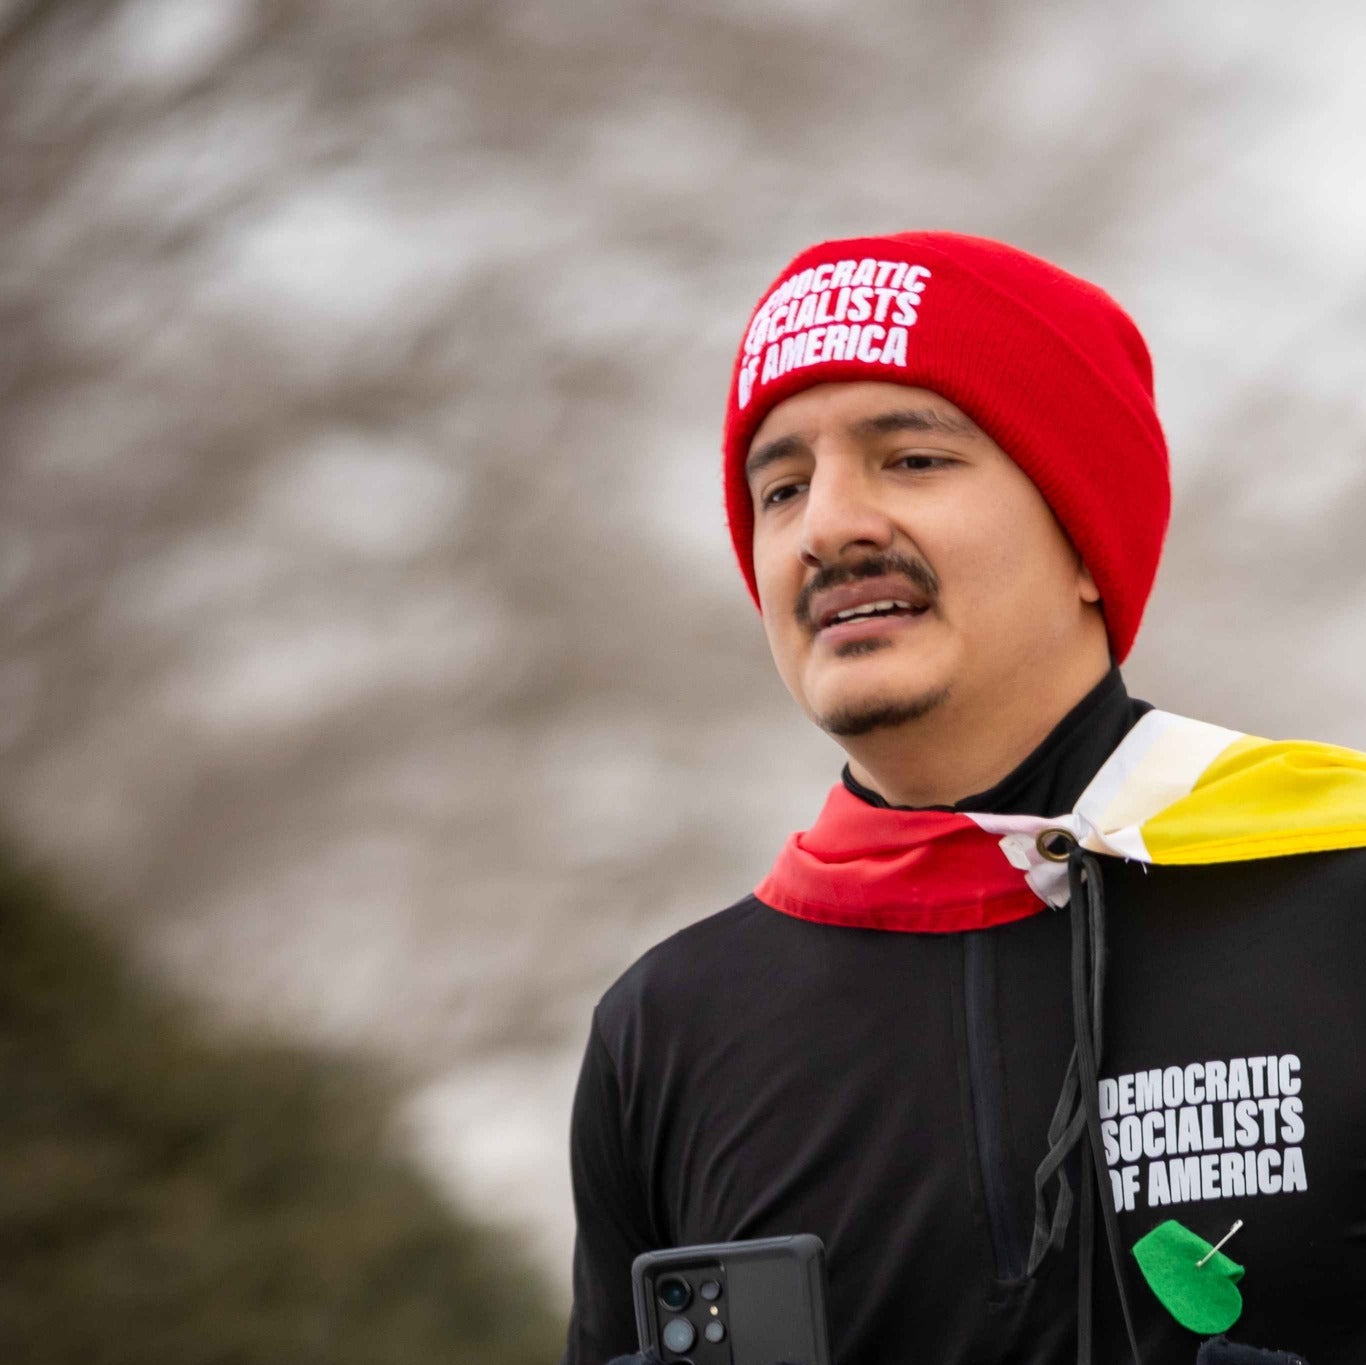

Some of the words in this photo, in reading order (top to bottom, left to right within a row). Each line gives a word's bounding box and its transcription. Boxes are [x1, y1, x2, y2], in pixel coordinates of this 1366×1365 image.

[761, 258, 932, 312] MOCRATIC
[744, 286, 922, 356] OCIALISTS
[761, 324, 909, 385] AMERICA
[1098, 1053, 1302, 1119] DEMOCRATIC
[1100, 1096, 1306, 1167] SOCIALISTS
[1147, 1146, 1308, 1207] AMERICA
